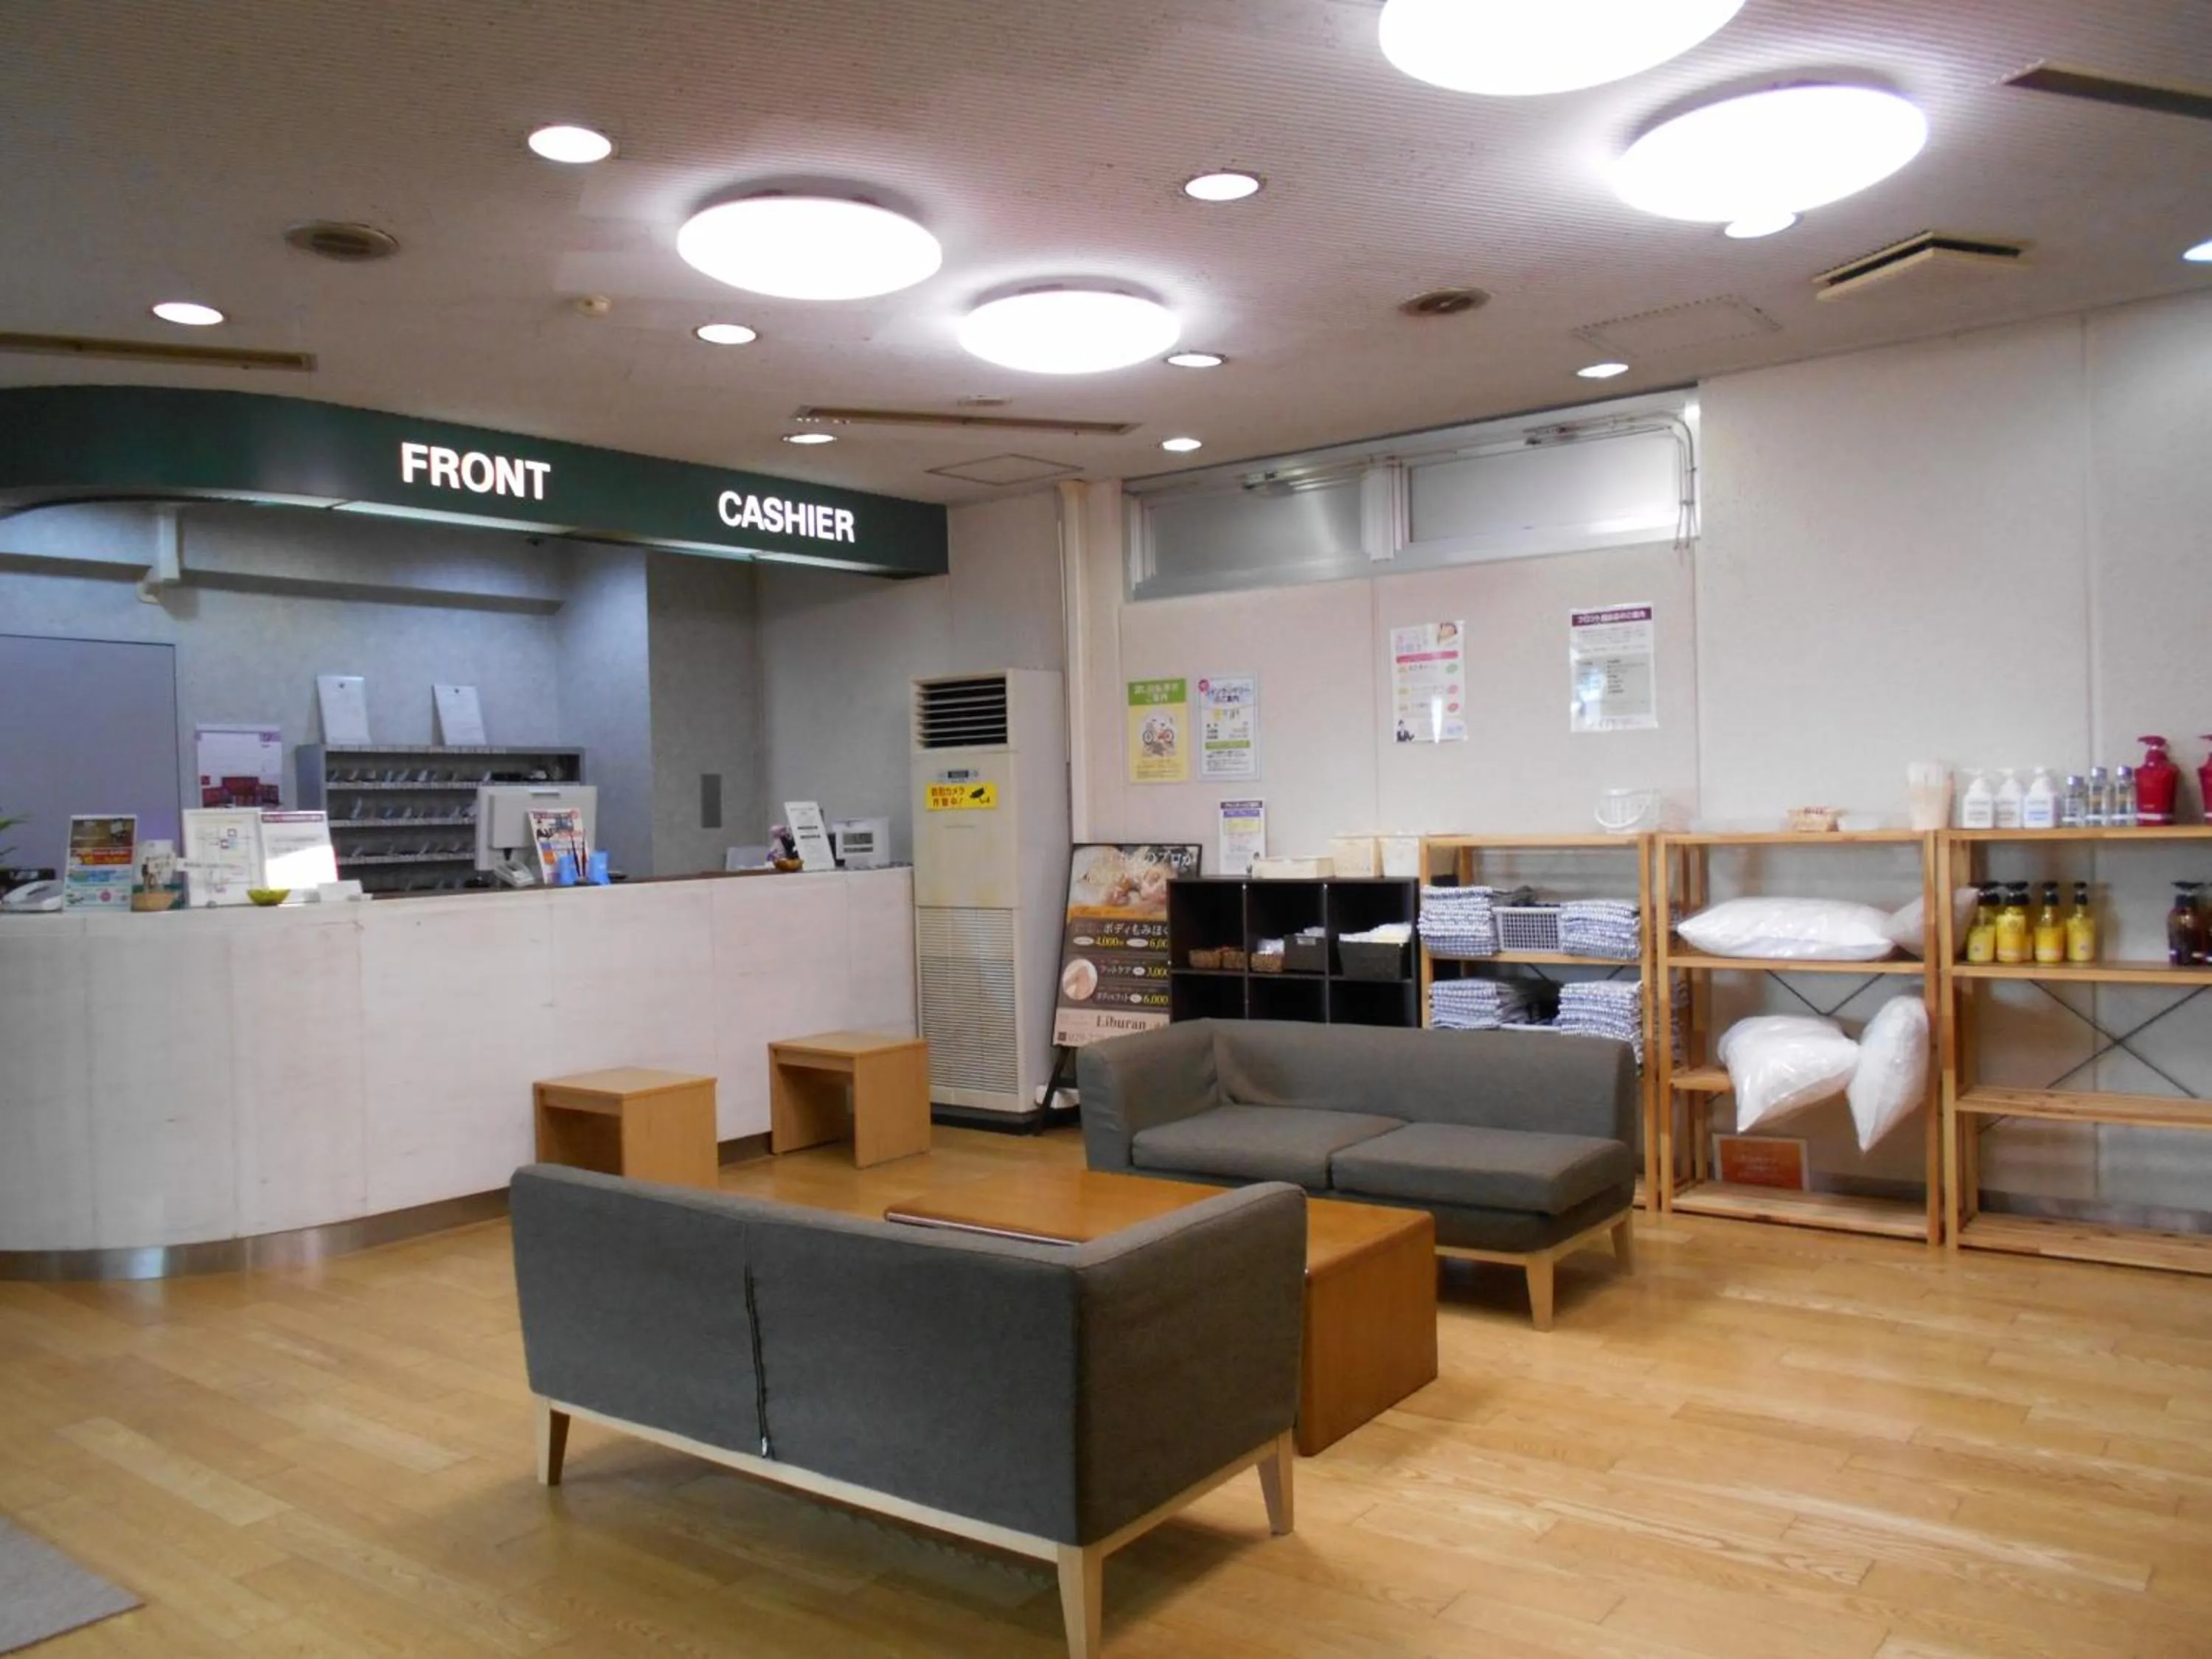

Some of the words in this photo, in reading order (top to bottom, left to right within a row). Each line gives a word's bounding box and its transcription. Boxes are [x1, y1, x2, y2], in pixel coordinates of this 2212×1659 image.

[401, 442, 551, 501] FRONT
[717, 490, 855, 543] CASHIER
[1096, 1015, 1147, 1030] Liburan
